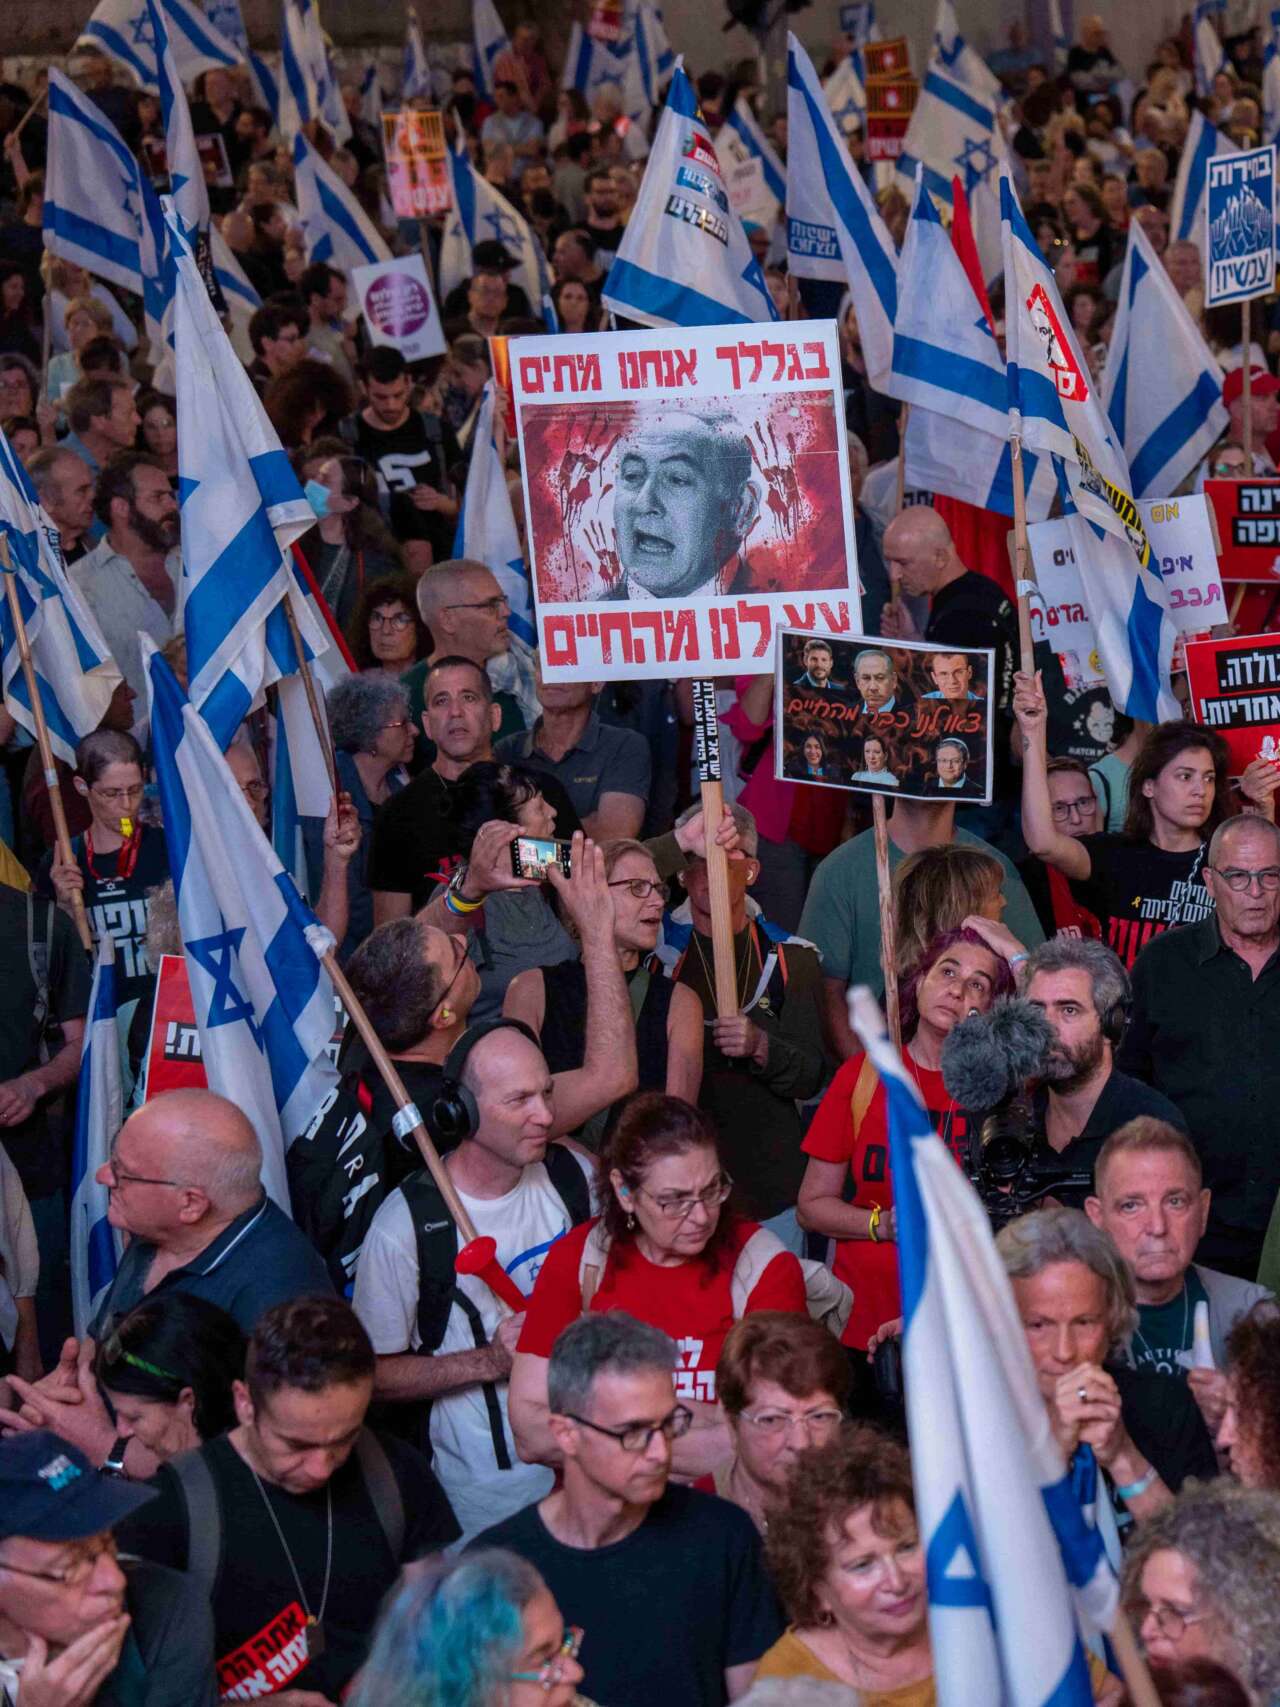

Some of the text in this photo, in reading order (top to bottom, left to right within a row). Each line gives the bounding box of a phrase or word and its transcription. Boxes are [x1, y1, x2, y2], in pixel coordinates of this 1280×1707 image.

[1210, 153, 1272, 188] בחירות
[1215, 254, 1269, 293] עכשיו!
[519, 340, 830, 394] בגללך אנחנו מתים
[1151, 501, 1180, 524] אם
[1161, 554, 1193, 575] איפ
[543, 609, 700, 666] מהחיים
[708, 600, 771, 660] לנו
[787, 699, 861, 722] מהחיים
[911, 704, 951, 738] לנו
[944, 712, 982, 734] צאו
[708, 738, 722, 780] ישראל
